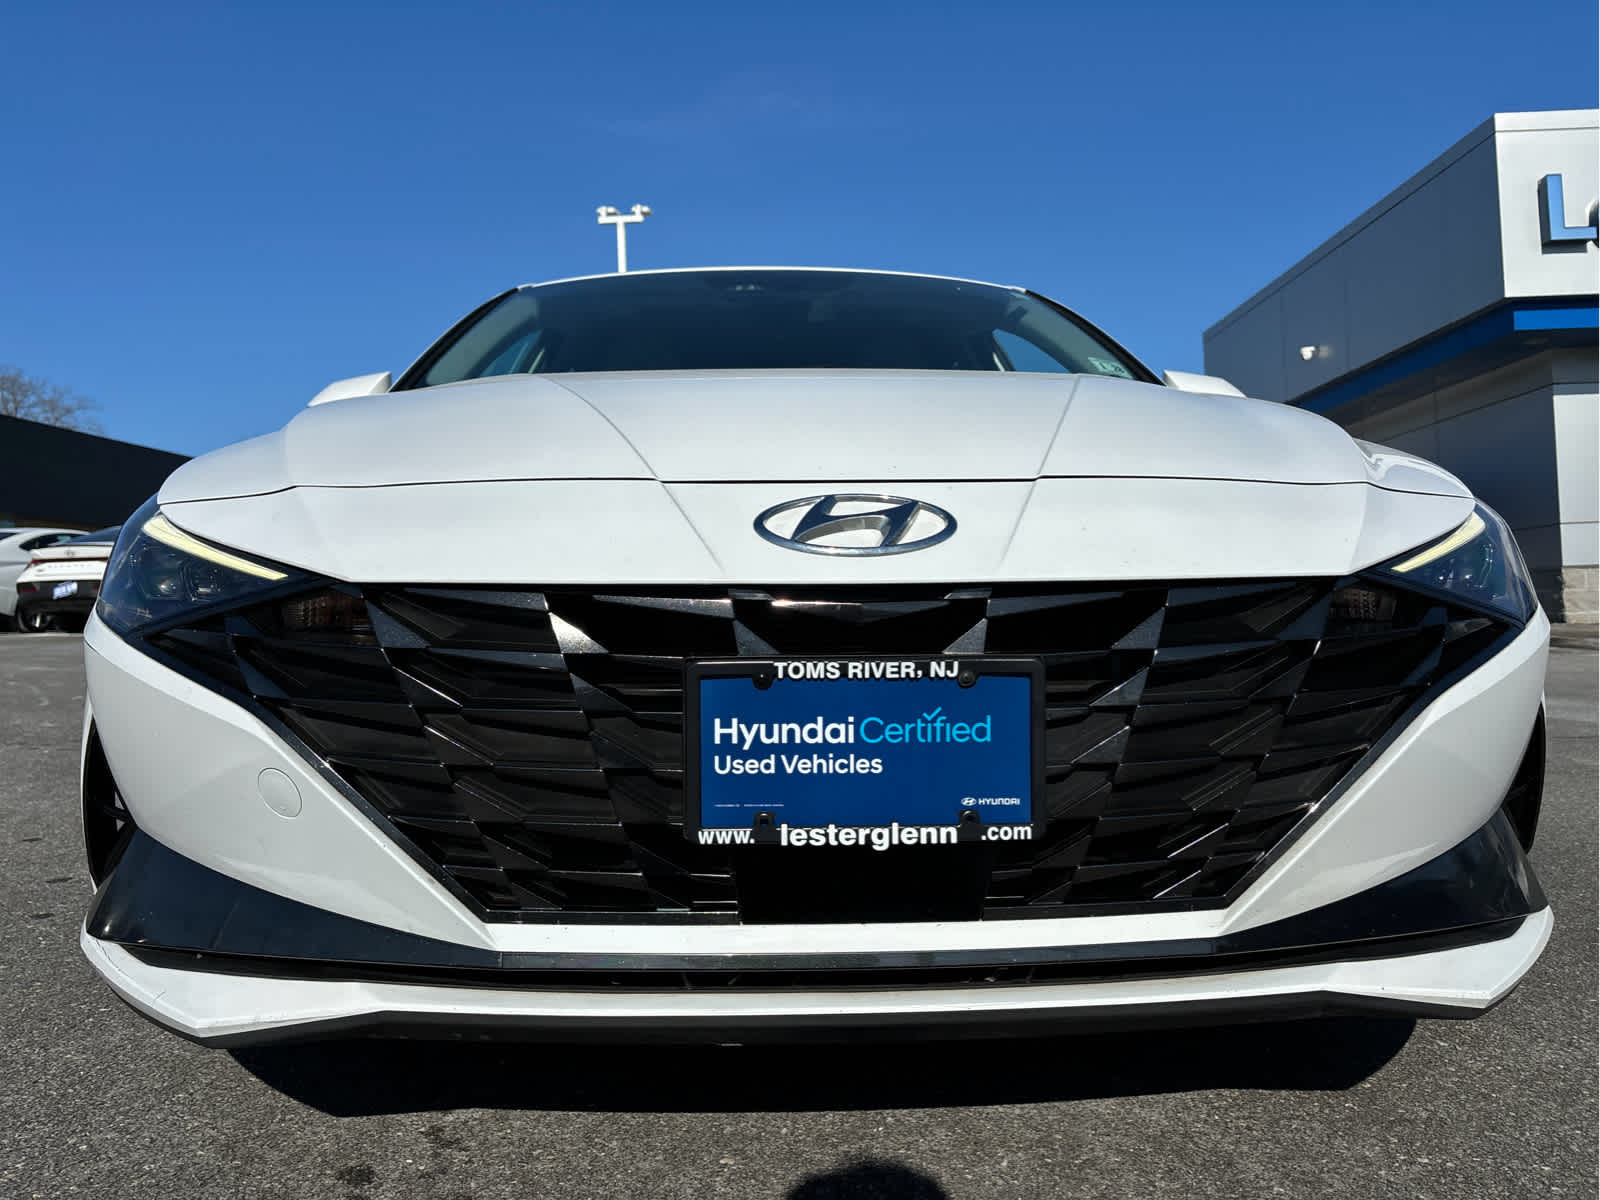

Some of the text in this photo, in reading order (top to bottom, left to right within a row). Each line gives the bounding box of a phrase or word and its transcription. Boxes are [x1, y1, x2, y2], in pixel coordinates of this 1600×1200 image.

[1537, 173, 1600, 254] L
[773, 661, 960, 679] TOMS RIVER, NJ
[713, 706, 992, 750] Hyundai Certified
[713, 753, 883, 775] Used Vehicles
[977, 797, 1021, 806] HYUNDAI
[697, 822, 1033, 851] www. lesterglenn .com
